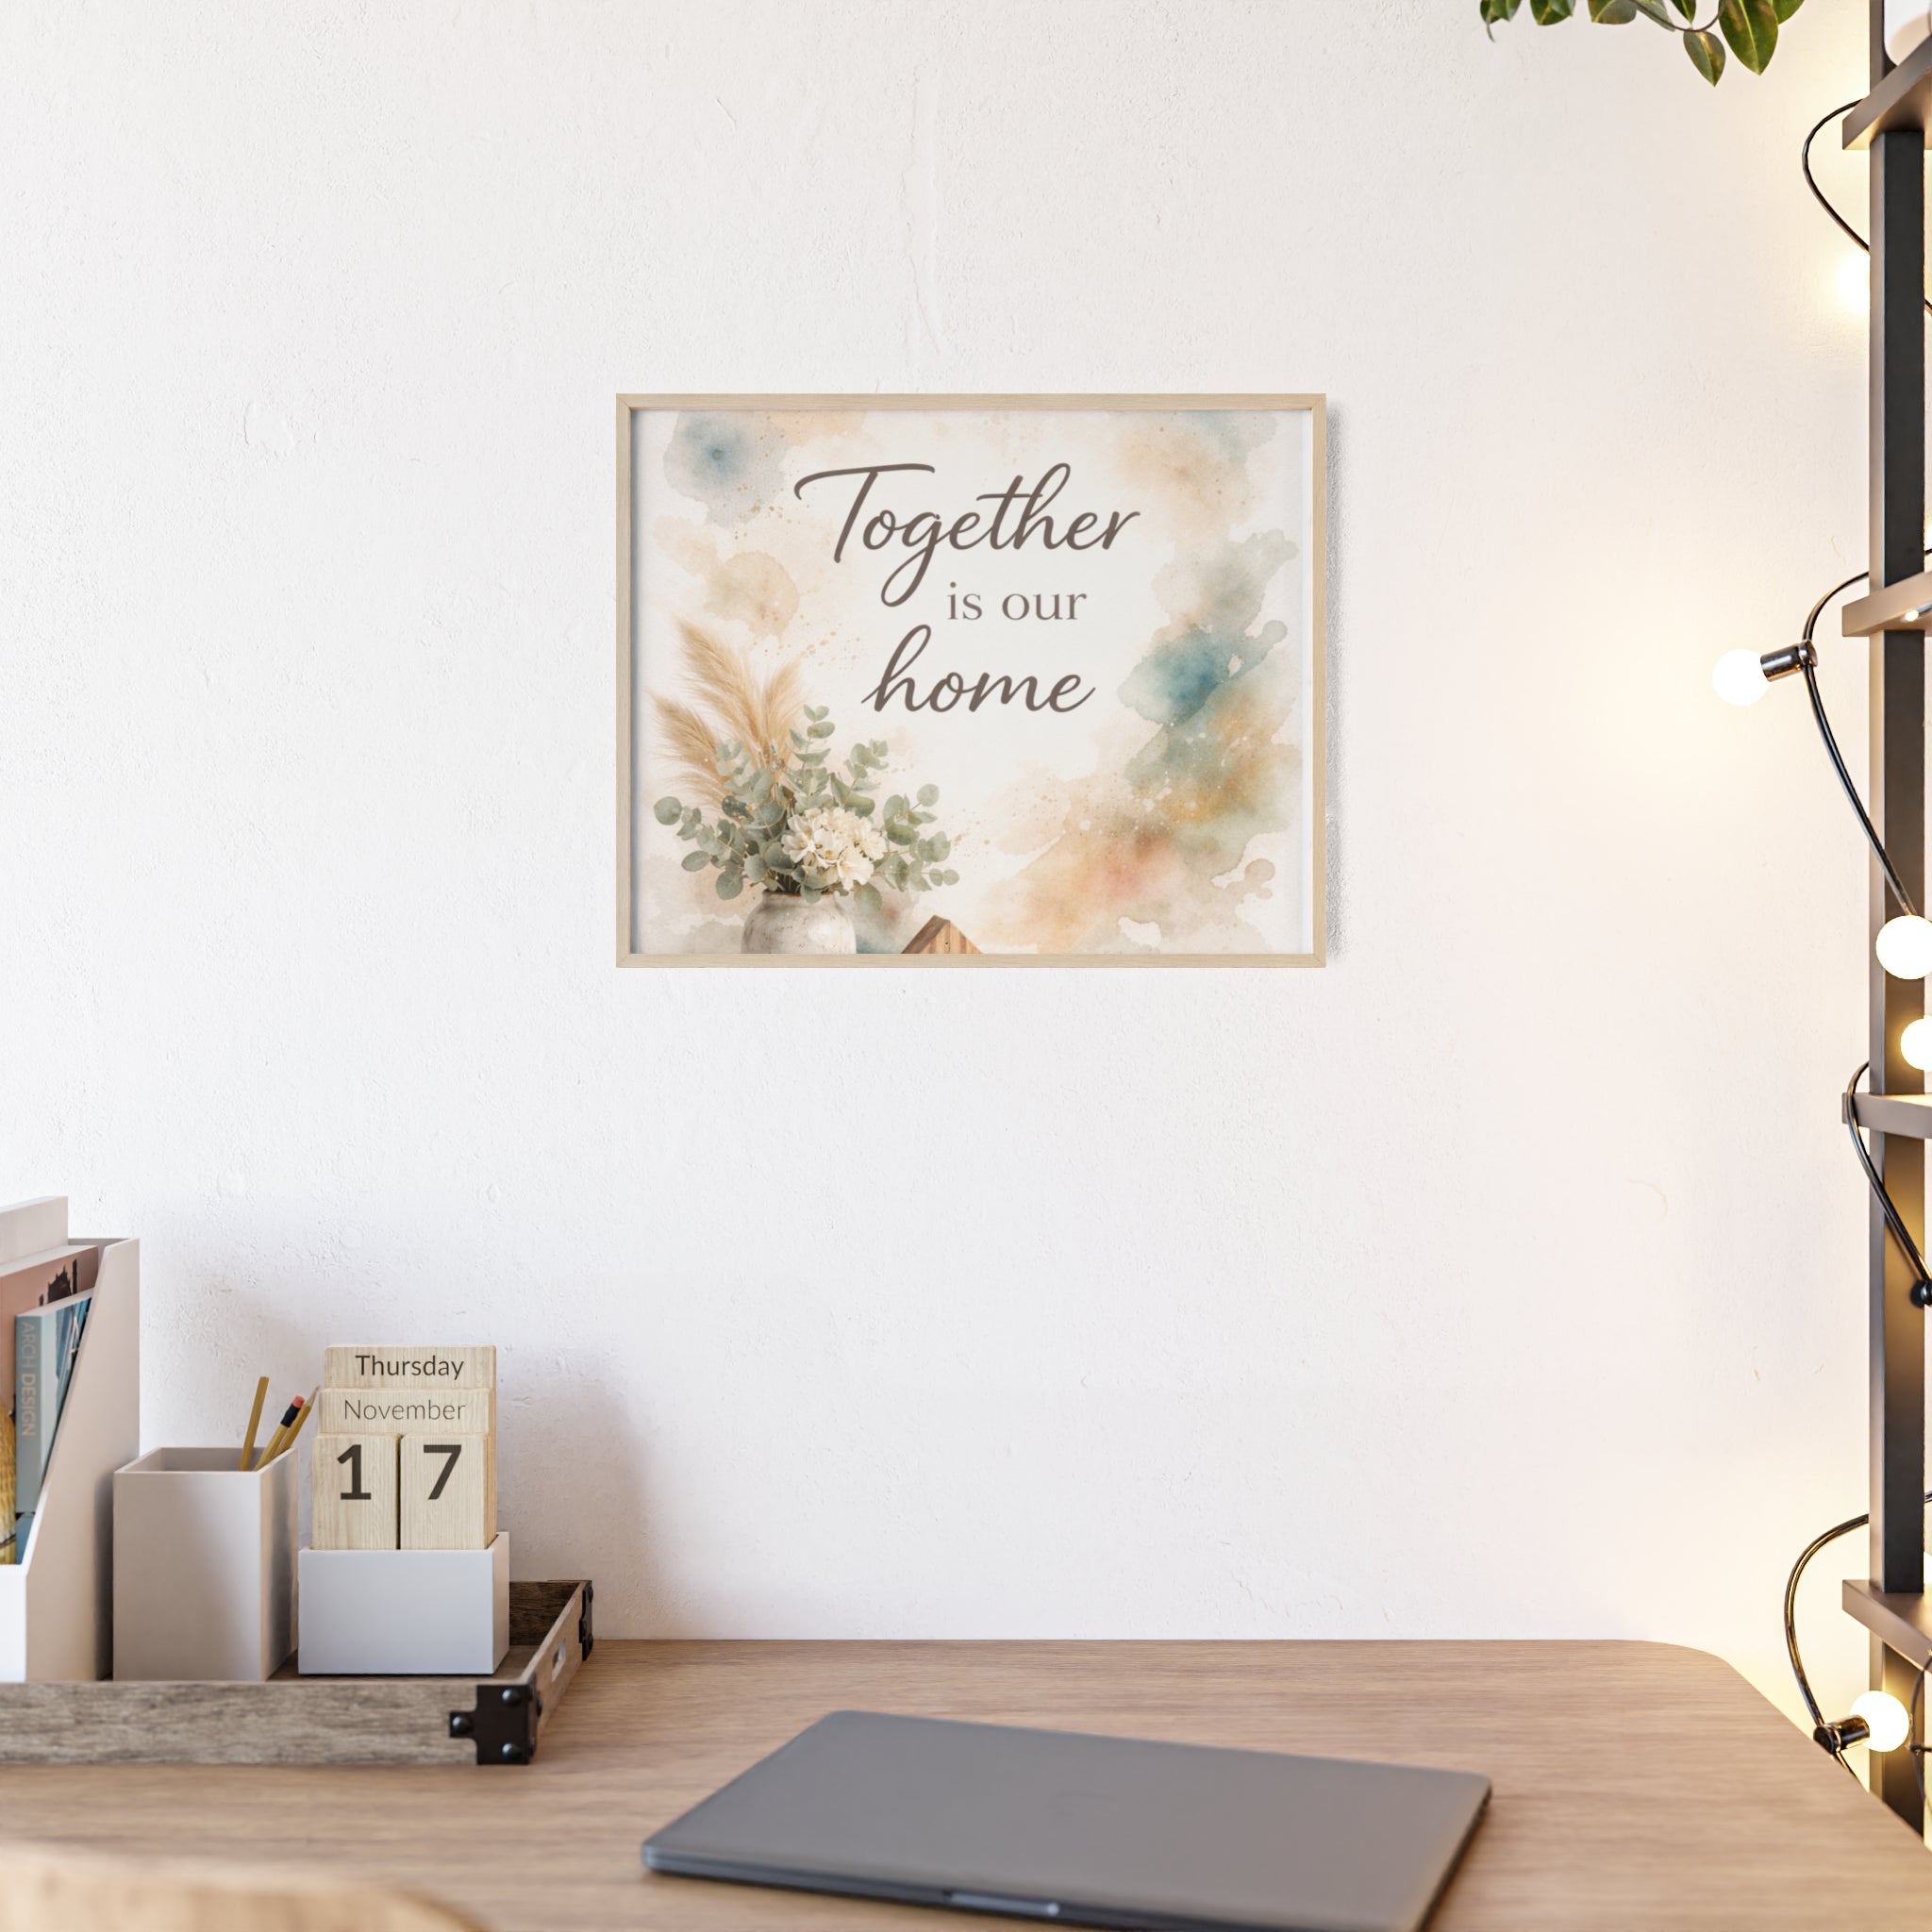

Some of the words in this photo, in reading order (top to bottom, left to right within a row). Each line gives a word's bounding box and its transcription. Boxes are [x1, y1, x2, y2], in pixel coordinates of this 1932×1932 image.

[794, 463, 1141, 607] Together
[947, 582, 983, 620] is
[1002, 593, 1087, 620] our
[861, 625, 1096, 712] home
[23, 1322, 36, 1368] ARCH
[355, 1355, 464, 1380] Thursday
[22, 1374, 37, 1437] DESIGN
[344, 1400, 466, 1420] November
[337, 1444, 372, 1500] 1
[423, 1444, 462, 1500] 7
